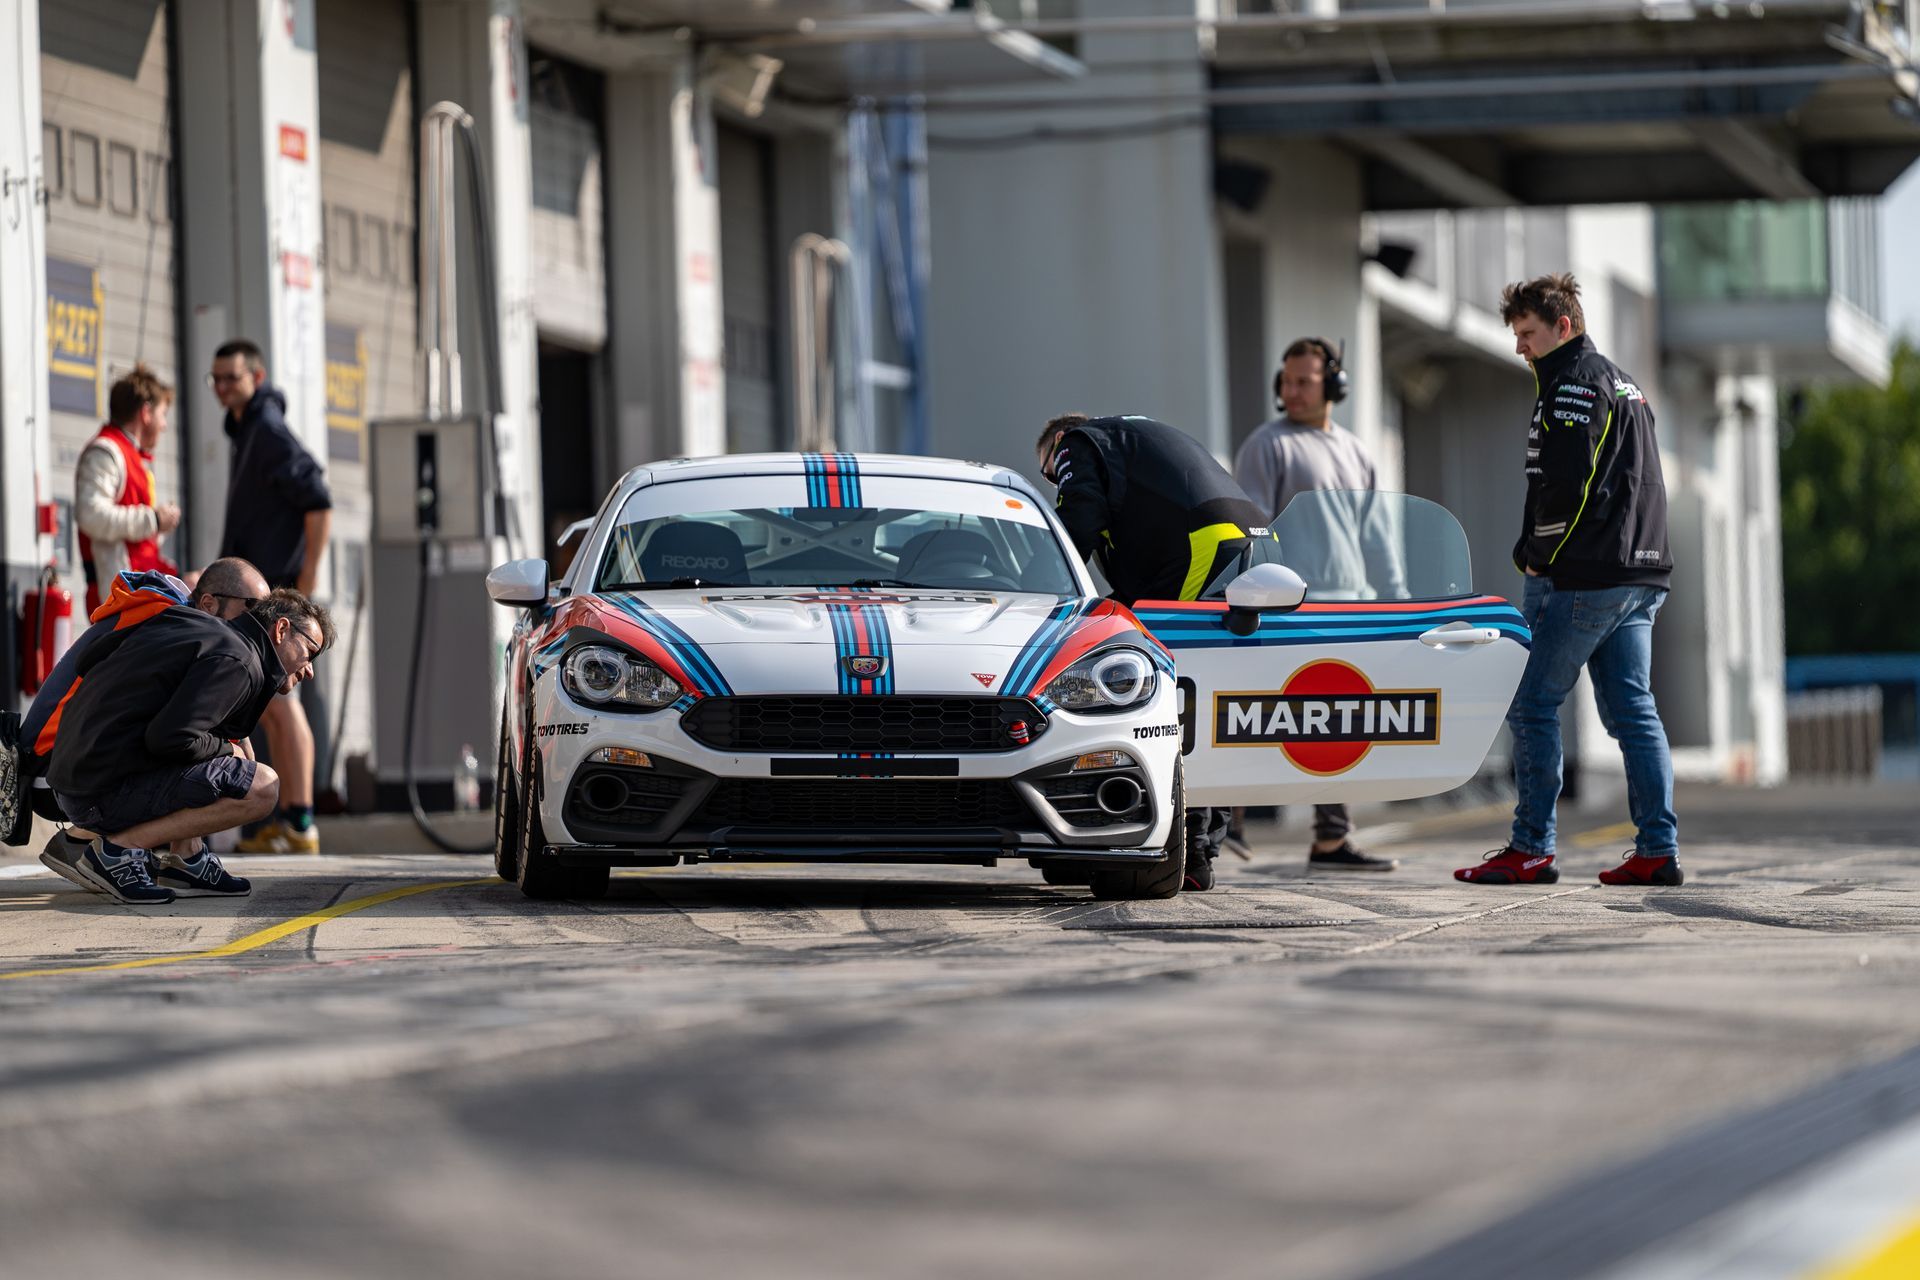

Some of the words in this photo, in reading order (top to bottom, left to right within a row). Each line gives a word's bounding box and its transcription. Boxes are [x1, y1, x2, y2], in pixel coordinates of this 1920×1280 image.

[1553, 409, 1591, 424] RECARO
[661, 554, 729, 570] RECARO
[1227, 699, 1426, 736] MARTINI
[538, 724, 556, 737] TOYO
[557, 722, 589, 735] TIRES
[1133, 726, 1160, 739] TOYO
[1161, 724, 1178, 736] TIRES
